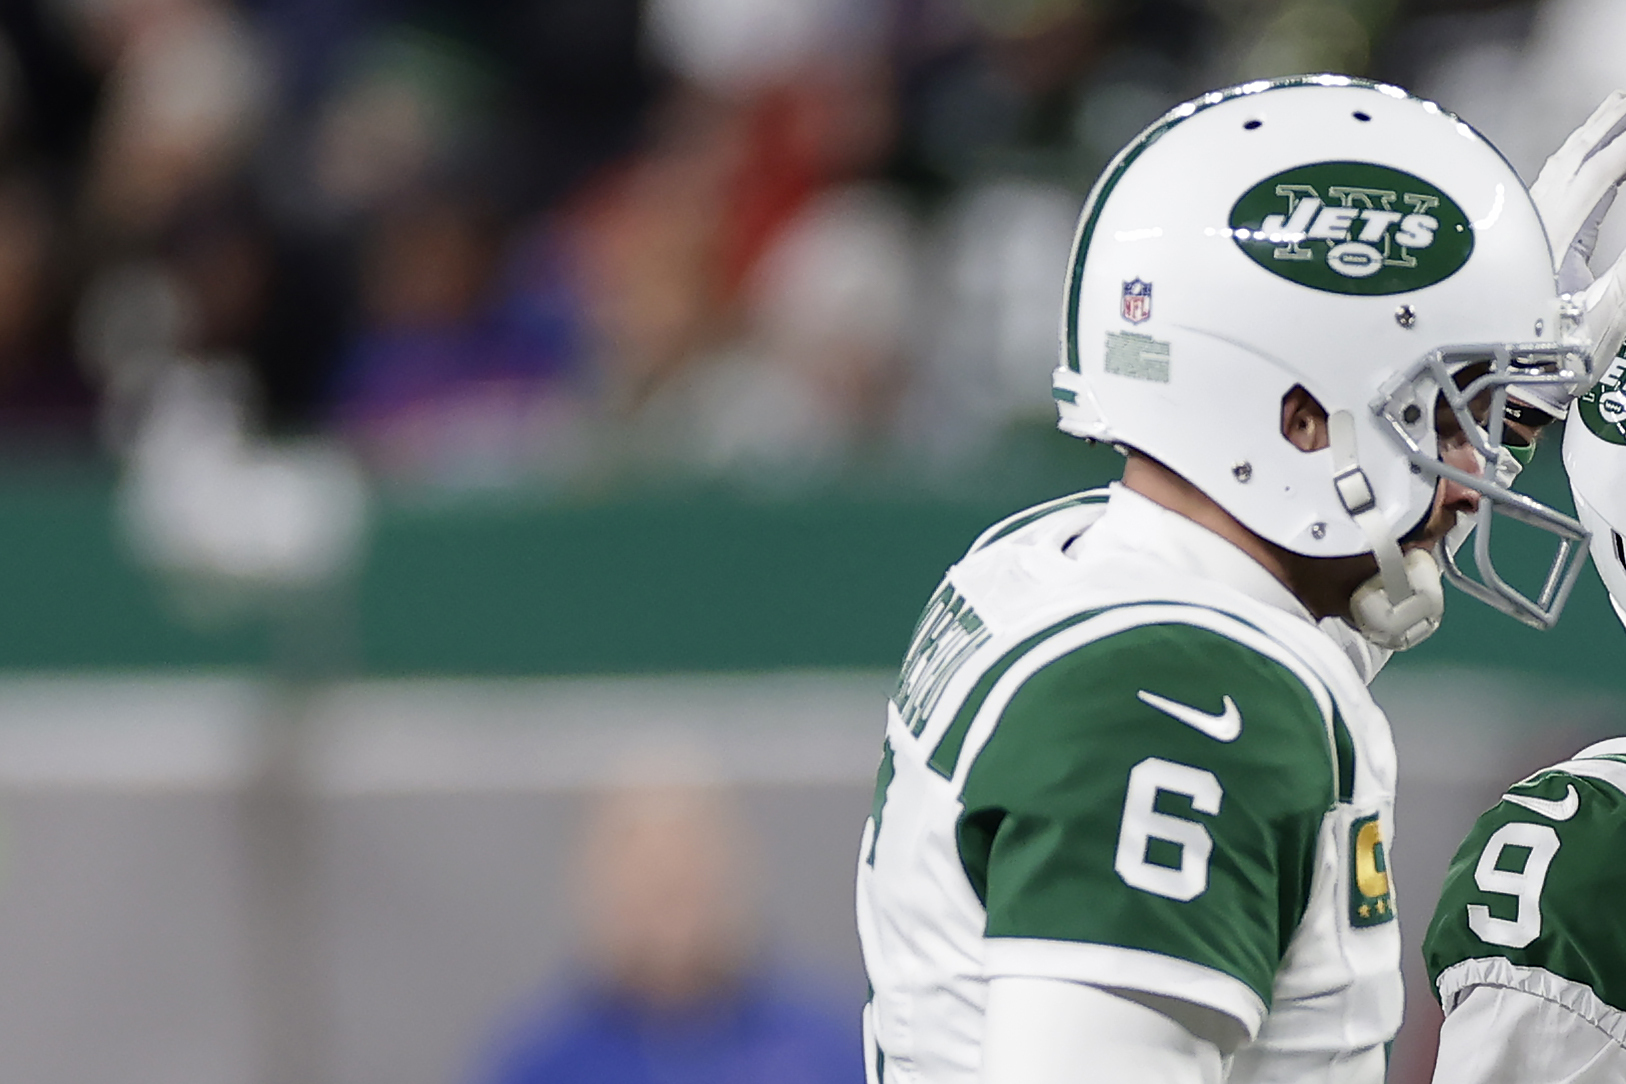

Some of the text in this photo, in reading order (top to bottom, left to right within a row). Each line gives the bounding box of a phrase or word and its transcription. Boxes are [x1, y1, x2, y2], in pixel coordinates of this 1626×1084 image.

[1261, 197, 1439, 249] JETS
[1114, 756, 1225, 903] 6
[1467, 821, 1562, 949] 9
